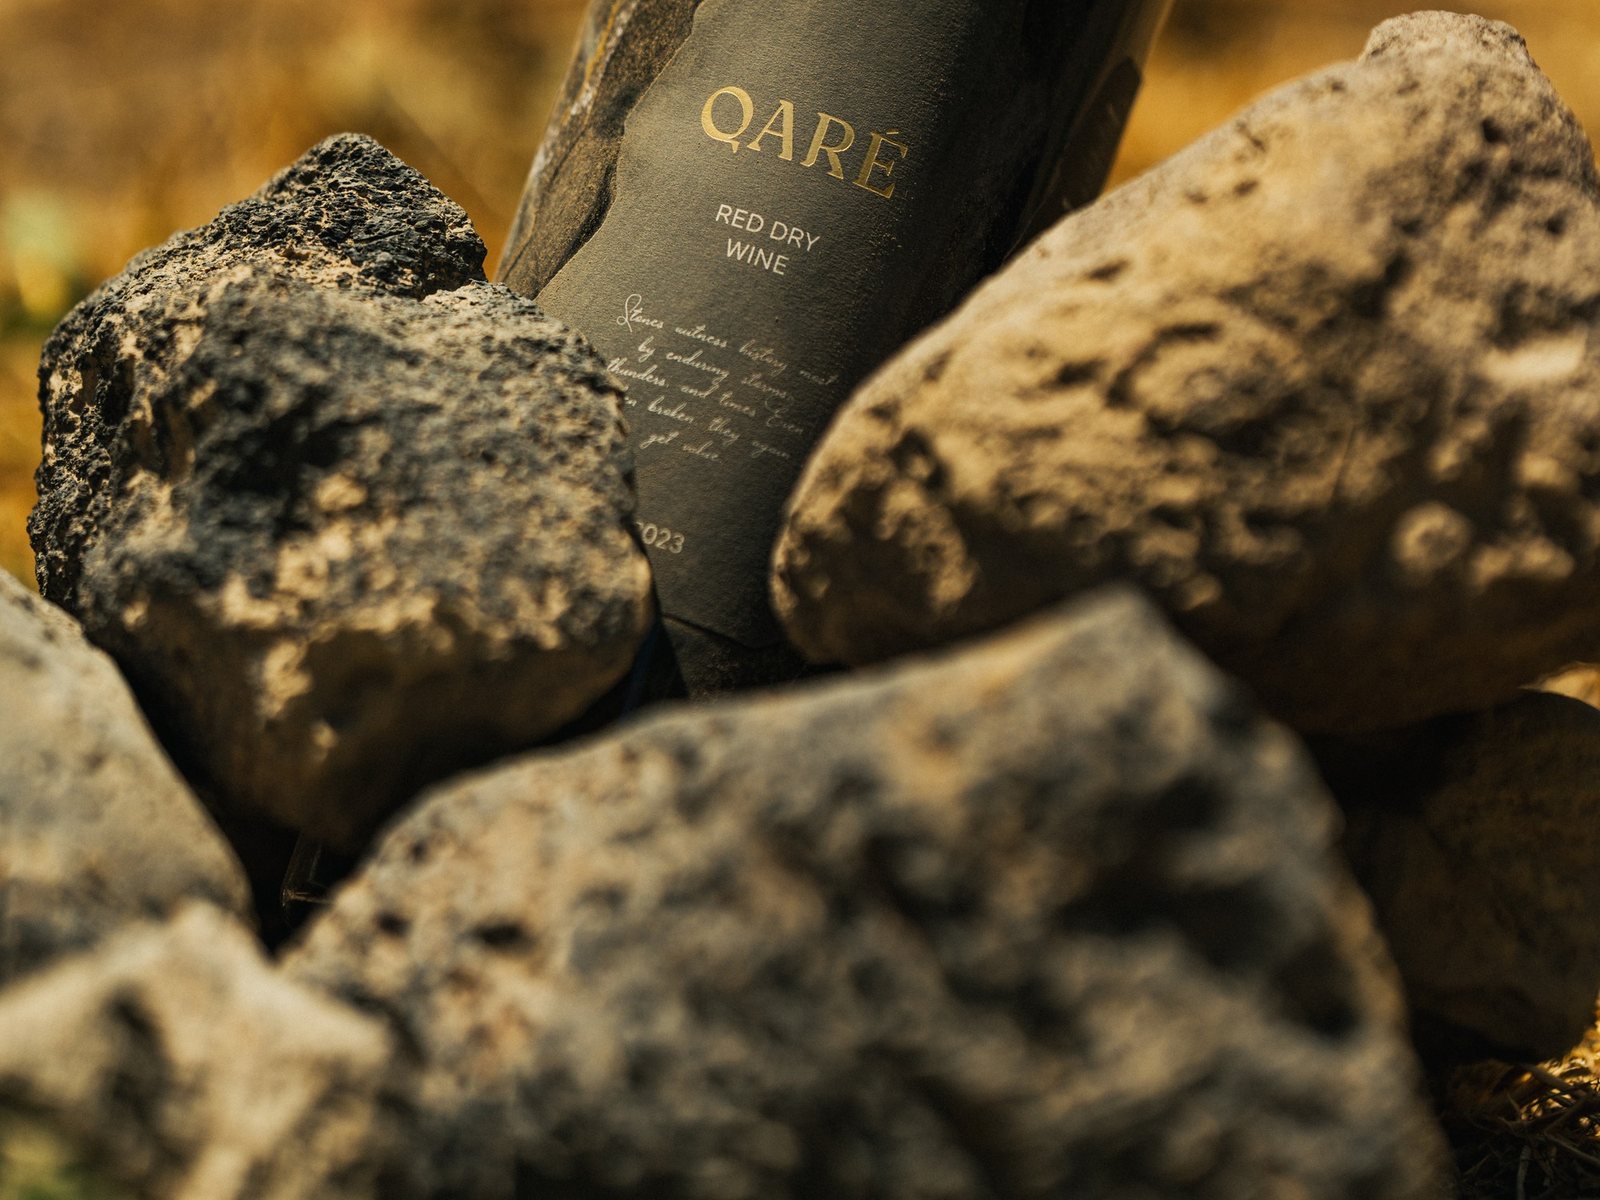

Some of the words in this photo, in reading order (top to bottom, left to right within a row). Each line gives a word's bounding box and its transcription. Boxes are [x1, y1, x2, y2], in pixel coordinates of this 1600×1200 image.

[700, 86, 909, 199] QARÉ
[715, 204, 764, 233] RED
[770, 221, 821, 252] DRY
[726, 238, 789, 276] WINE
[616, 293, 664, 333] Stones
[675, 324, 728, 349] witness
[739, 339, 788, 377] history
[637, 335, 656, 363] by
[666, 350, 730, 386] enduring
[680, 384, 720, 399] and
[639, 430, 680, 450] get
[635, 521, 686, 554] 023
